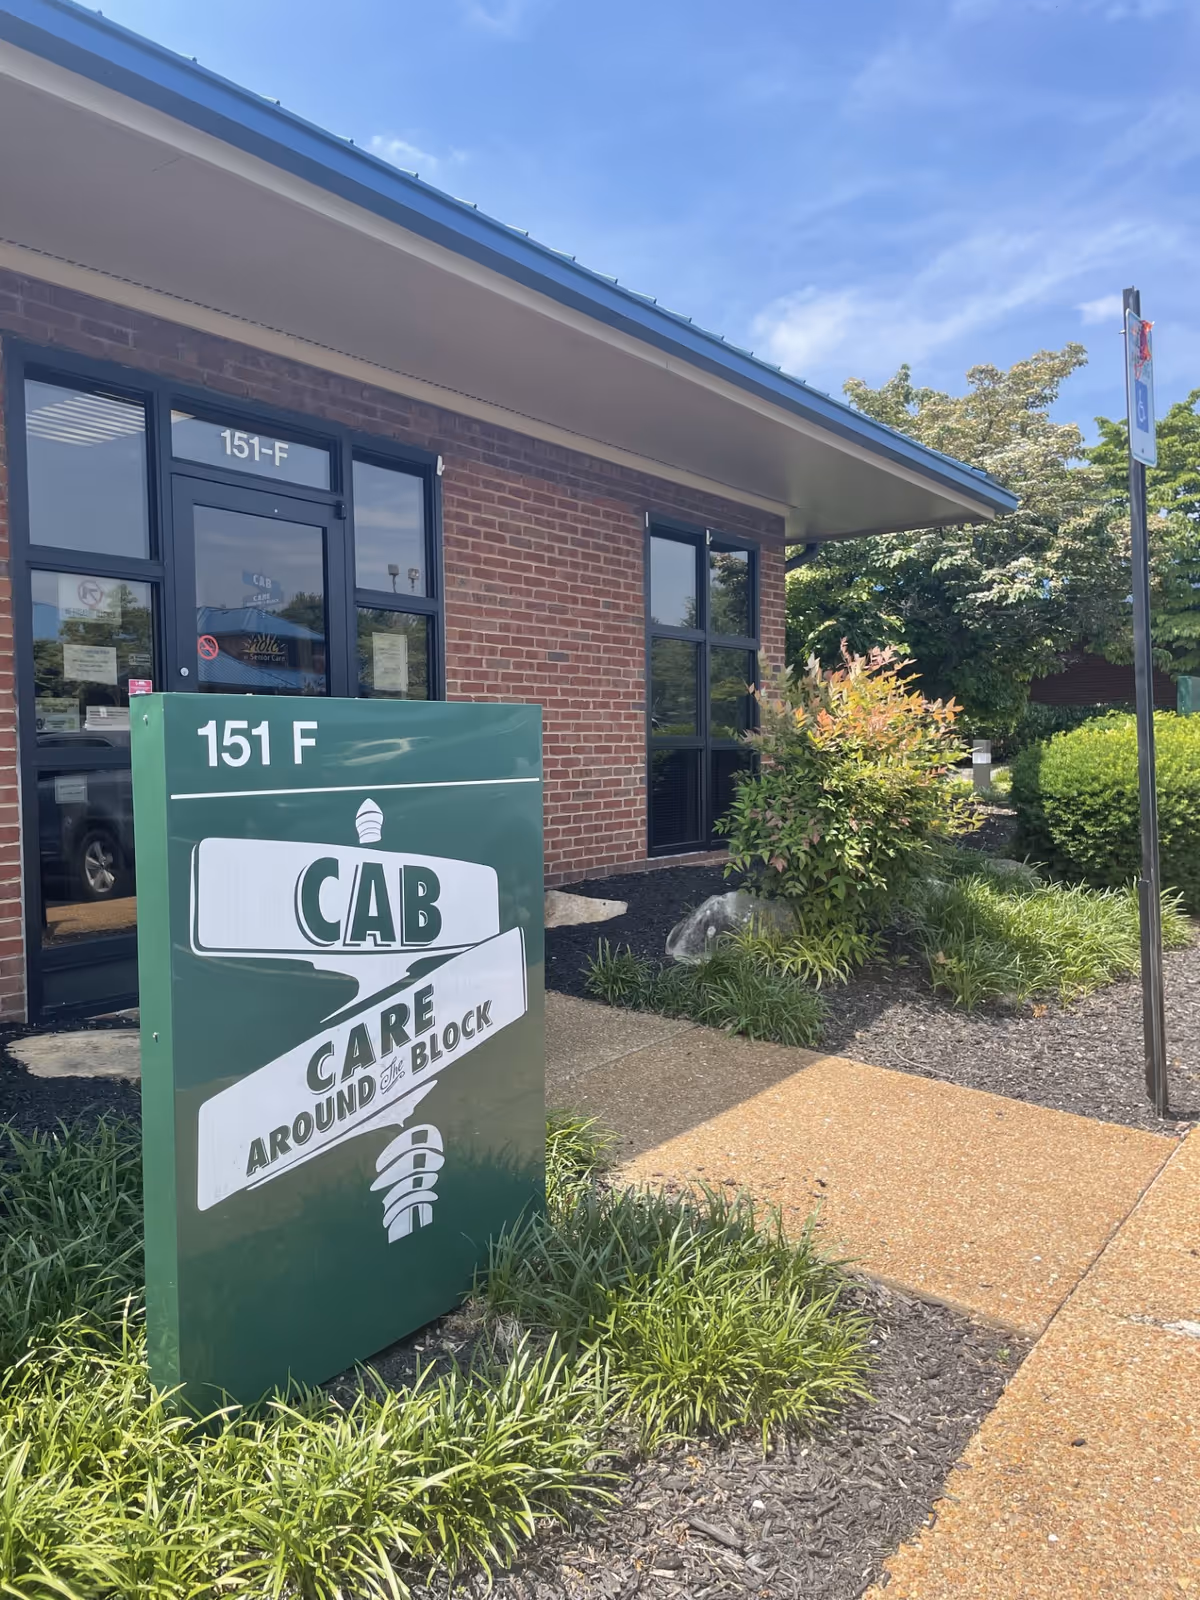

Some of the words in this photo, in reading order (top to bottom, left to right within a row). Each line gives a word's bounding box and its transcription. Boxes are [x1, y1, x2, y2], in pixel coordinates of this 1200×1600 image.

[220, 429, 289, 467] 151-F
[253, 574, 272, 589] CAB
[249, 653, 270, 661] Senior
[271, 654, 286, 662] Care
[197, 720, 271, 767] 151
[293, 720, 318, 765] F
[294, 856, 442, 947] CAB
[306, 983, 436, 1095] CARE
[246, 1075, 376, 1178] AROUND
[380, 1056, 406, 1094] The
[411, 999, 495, 1075] BLOCK
